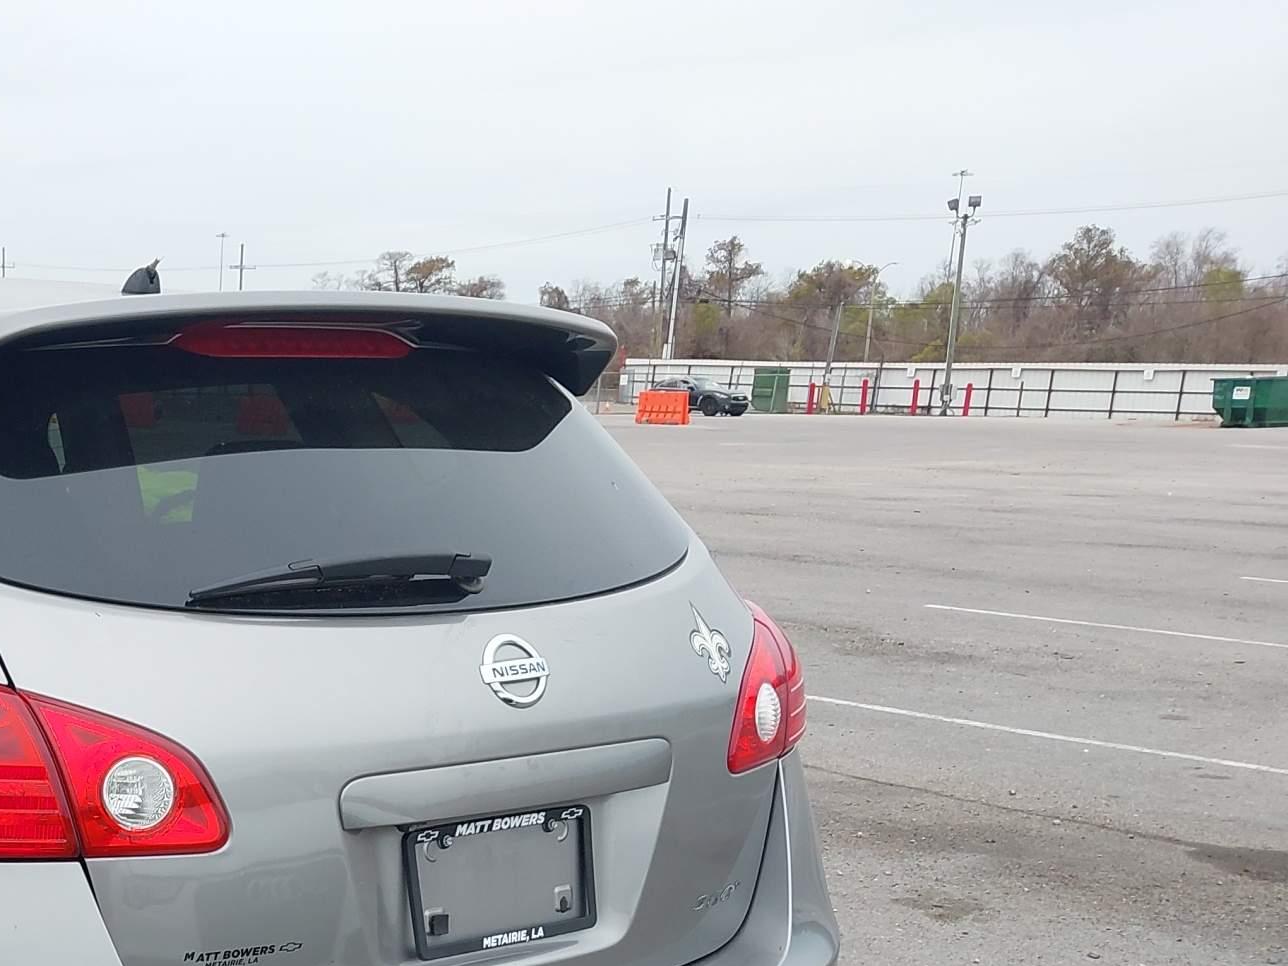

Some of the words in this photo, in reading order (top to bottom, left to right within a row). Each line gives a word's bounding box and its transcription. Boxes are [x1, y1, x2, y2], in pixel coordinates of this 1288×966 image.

[492, 661, 545, 678] NISSAN
[455, 819, 491, 837] MATT
[493, 812, 546, 830] BOWERS
[482, 928, 530, 949] METAIRIE,
[531, 926, 545, 940] LA
[183, 950, 222, 963] MATT
[223, 944, 276, 960] BOWERS
[247, 956, 259, 965] LA
